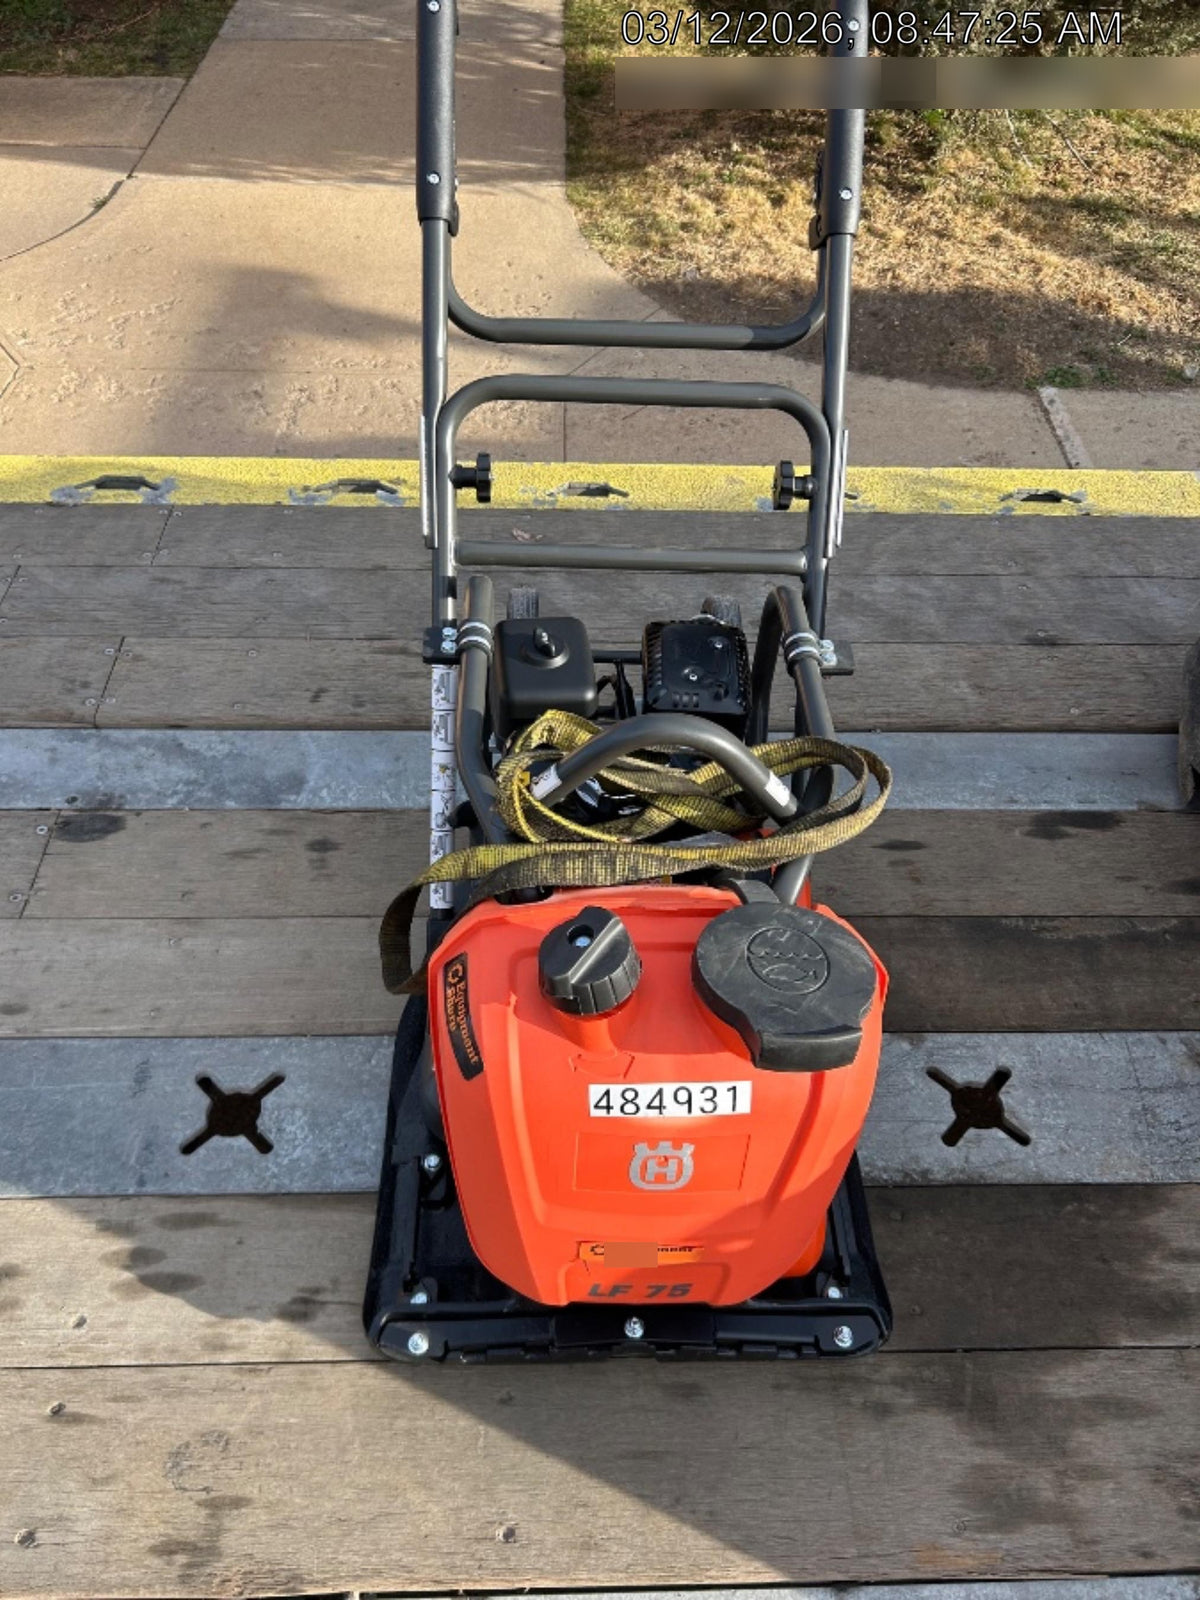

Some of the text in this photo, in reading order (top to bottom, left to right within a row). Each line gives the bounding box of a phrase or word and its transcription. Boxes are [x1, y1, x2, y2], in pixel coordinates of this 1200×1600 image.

[593, 1085, 737, 1115] 484931
[588, 1283, 693, 1298] LF 75
